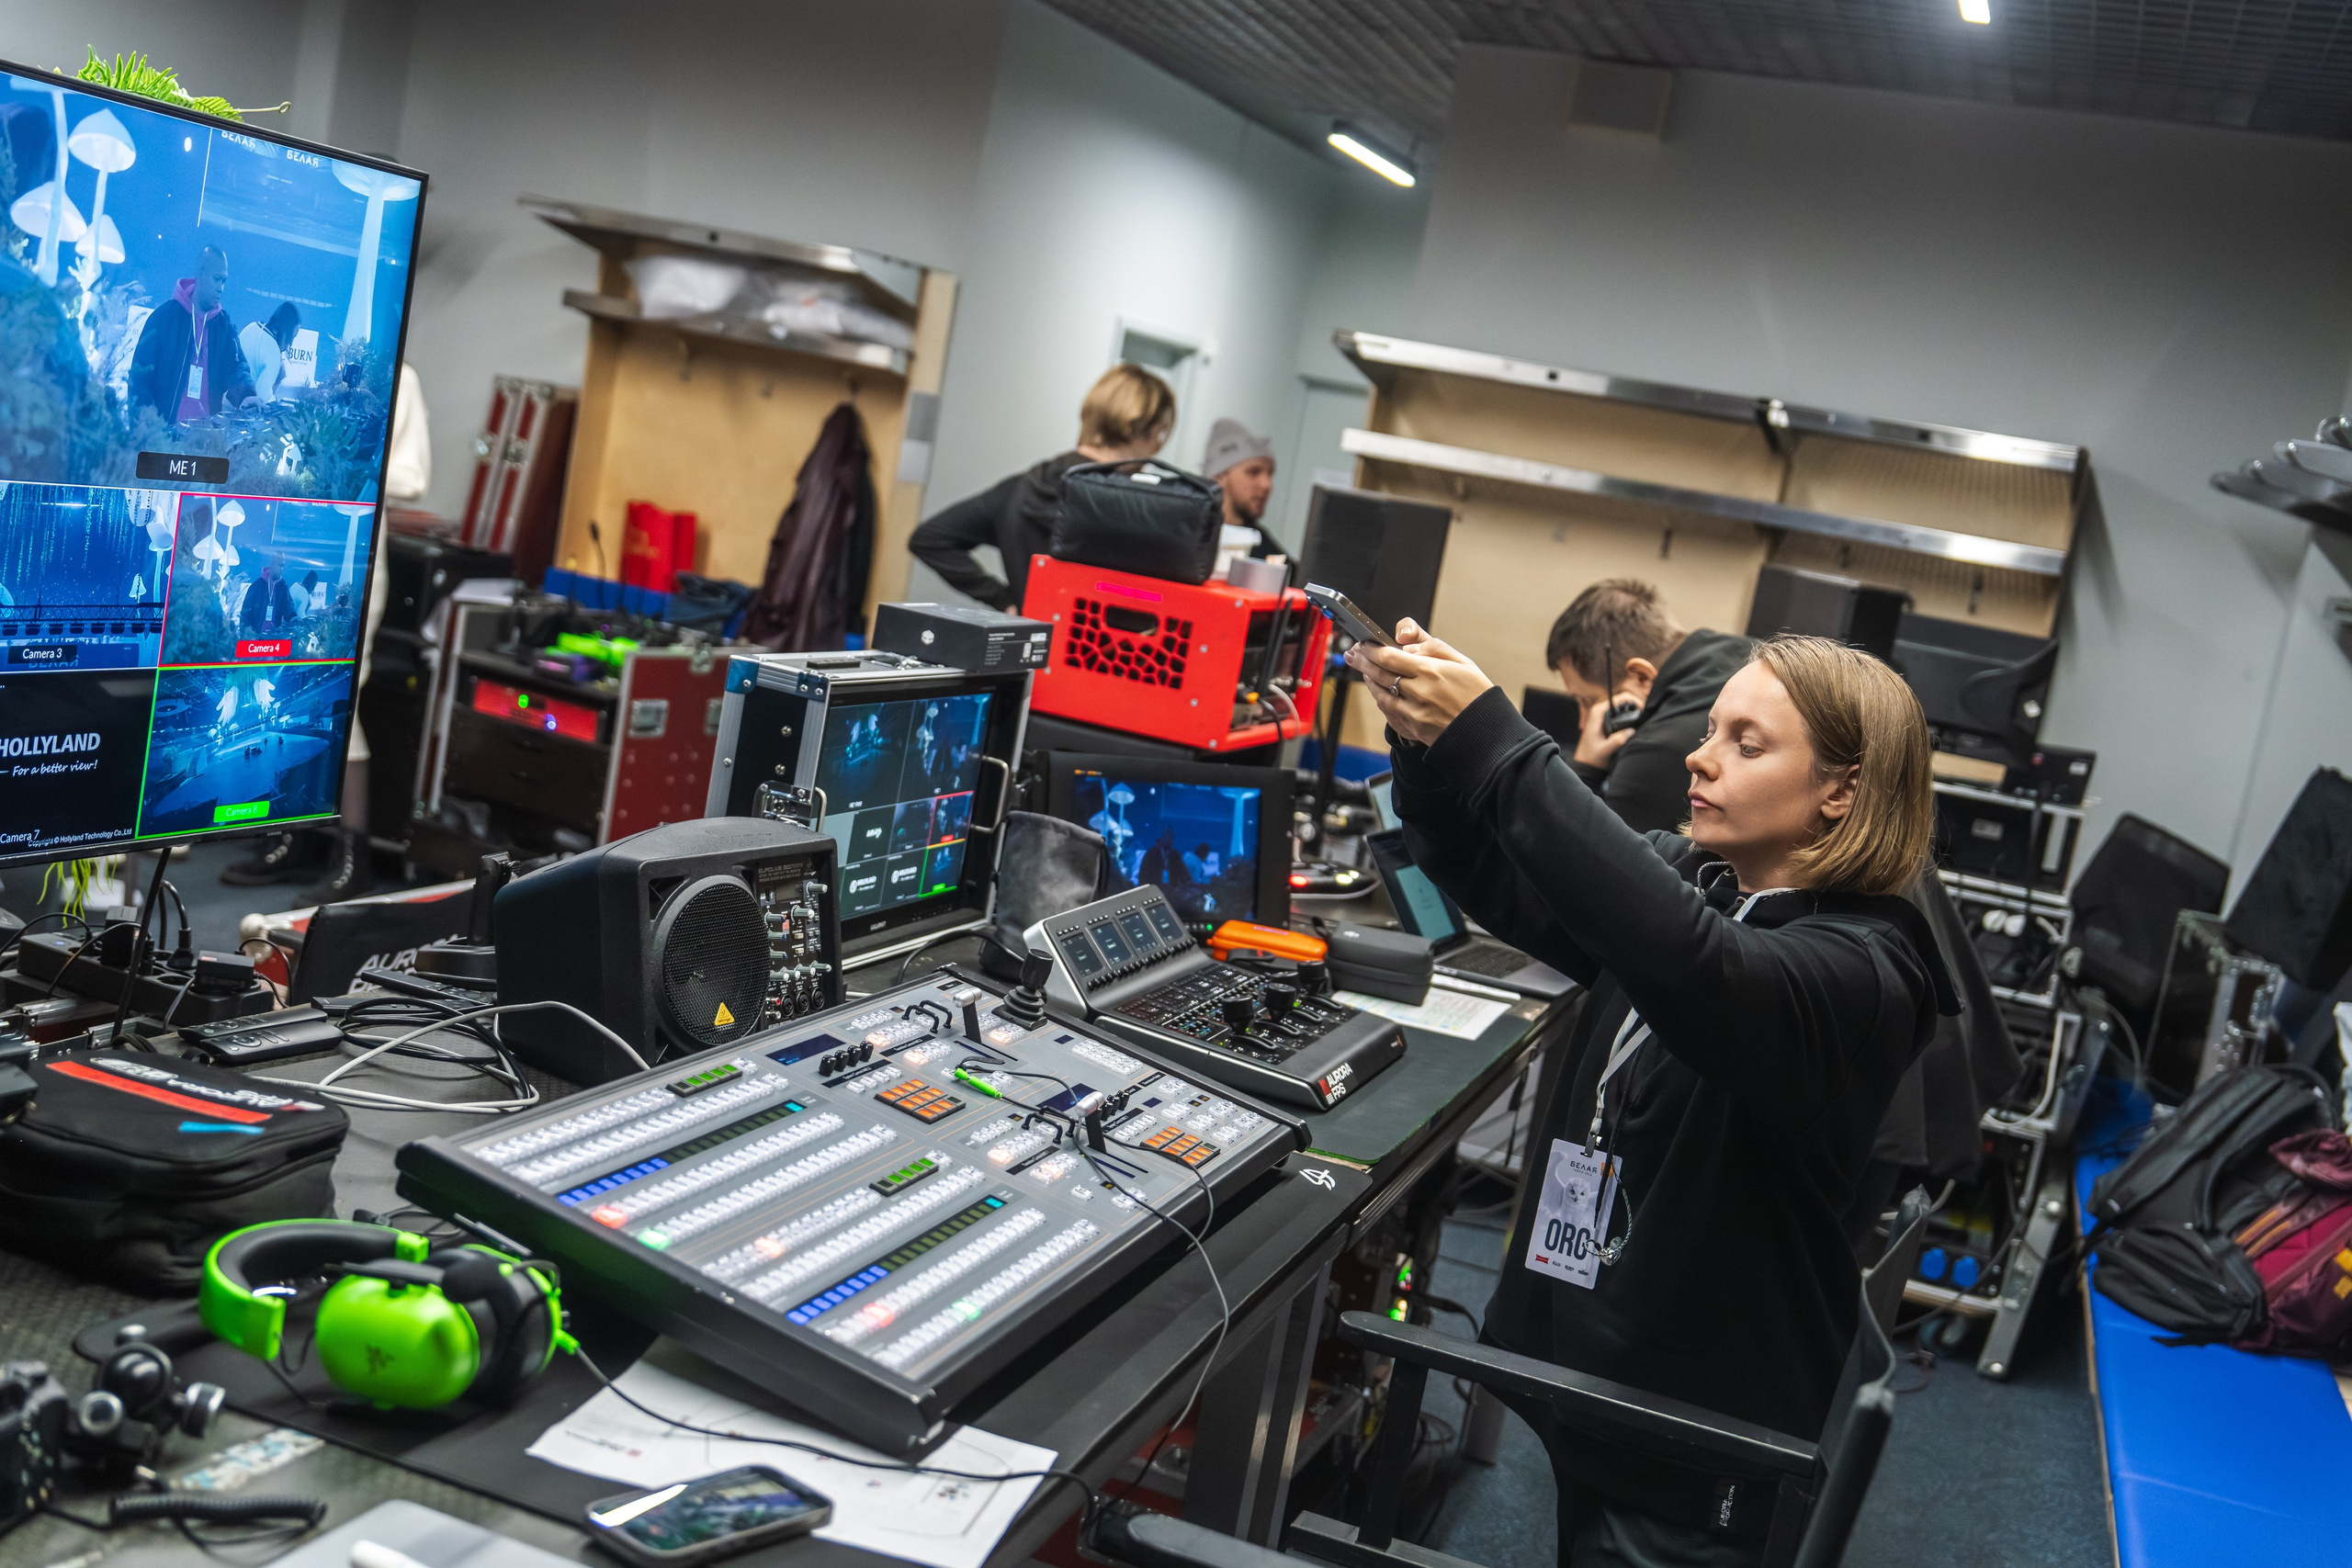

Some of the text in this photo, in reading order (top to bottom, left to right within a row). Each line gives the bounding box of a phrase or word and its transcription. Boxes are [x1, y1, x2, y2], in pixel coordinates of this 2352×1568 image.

[286, 149, 319, 167] БЕЛАЯ
[288, 347, 313, 362] BURN
[169, 459, 197, 476] ME 1
[22, 648, 62, 660] Camera 3
[247, 643, 280, 653] Camera 4
[0, 732, 101, 758] HOLLYLAND
[12, 765, 30, 777] For
[40, 763, 69, 774] better
[70, 759, 98, 773] view!
[226, 805, 258, 817] Camera 8
[0, 829, 40, 844] Camera 7
[60, 833, 85, 844] Hollyland
[85, 829, 113, 840] Technology
[1326, 1063, 1354, 1088] AURORA
[1330, 1082, 1347, 1100] FPS
[1569, 1160, 1598, 1174] БЕЛАЯ
